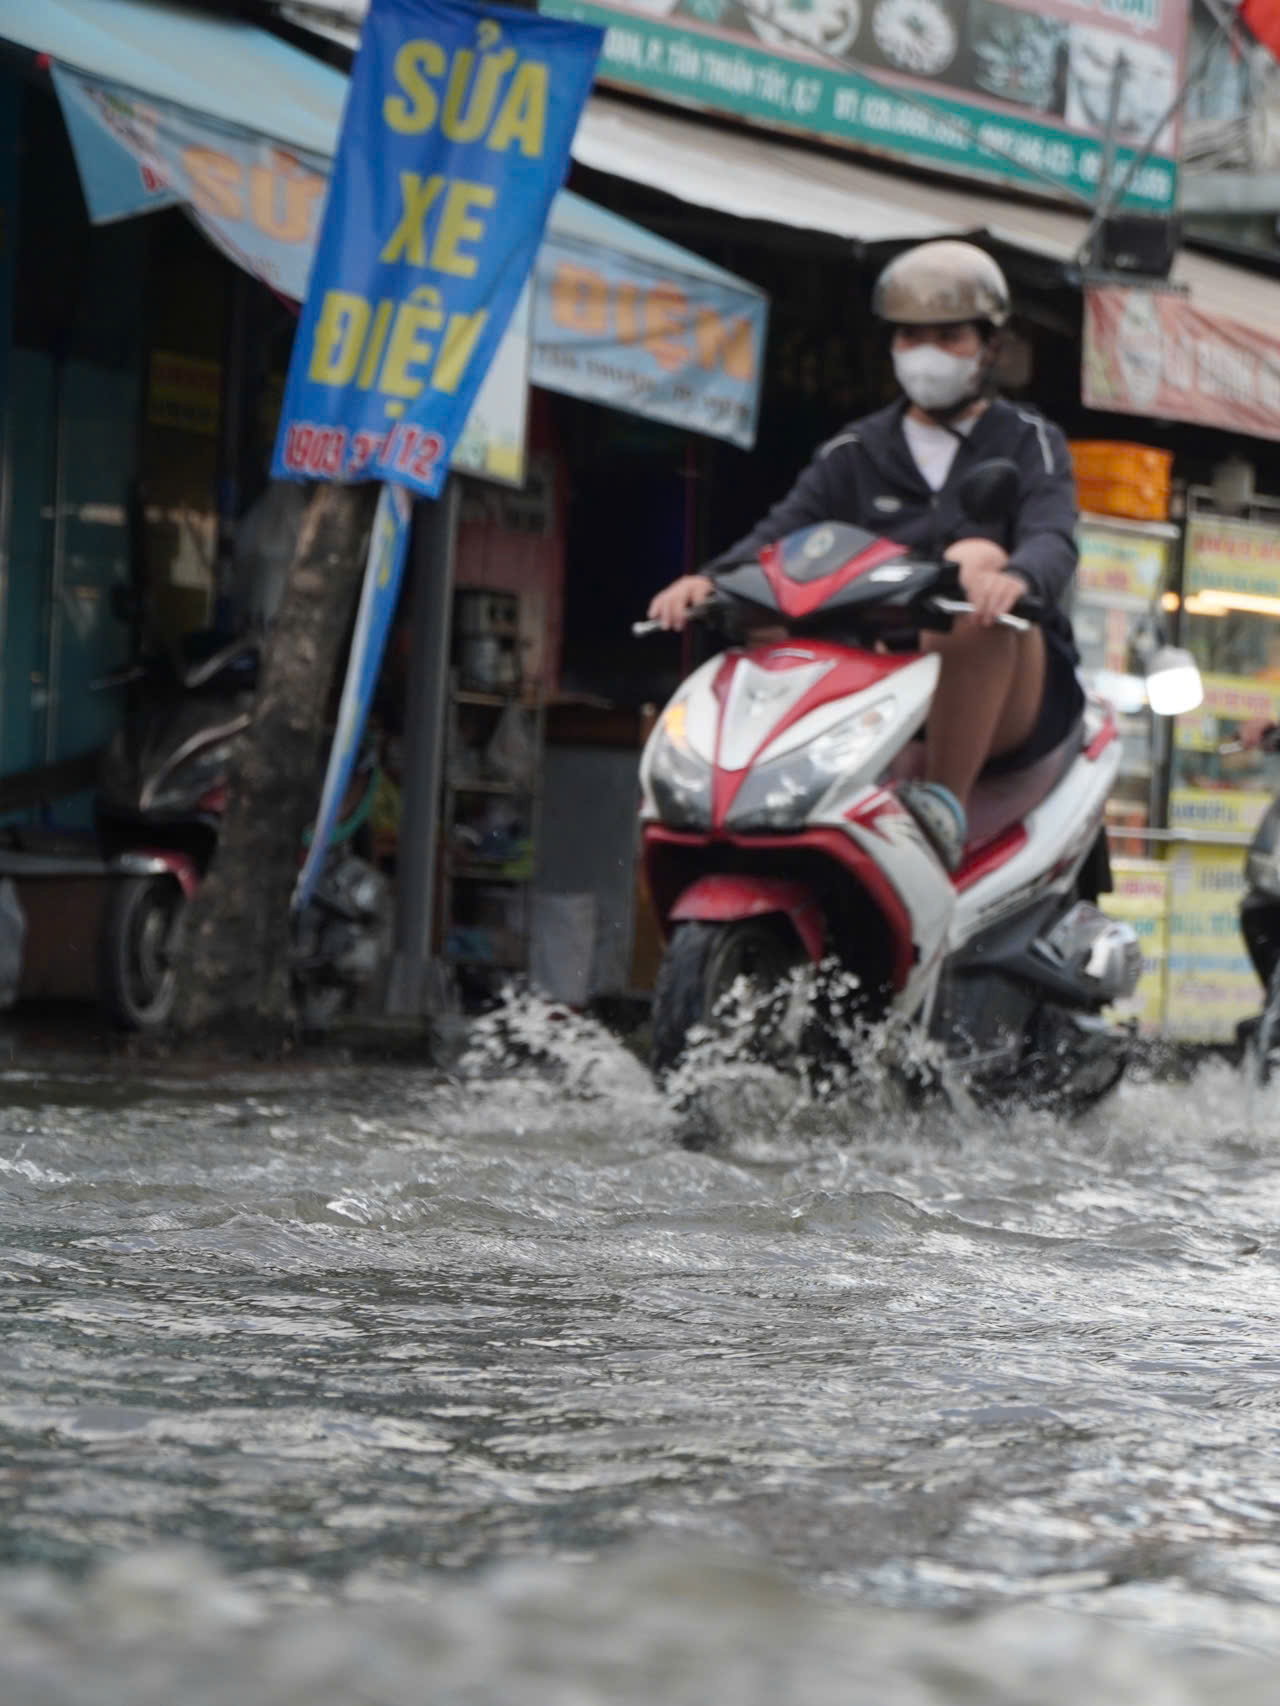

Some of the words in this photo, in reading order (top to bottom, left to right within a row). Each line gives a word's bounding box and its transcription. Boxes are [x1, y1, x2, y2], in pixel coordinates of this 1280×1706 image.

[382, 18, 548, 158] SỬA
[180, 142, 328, 244] SỬ
[379, 171, 496, 278] XE
